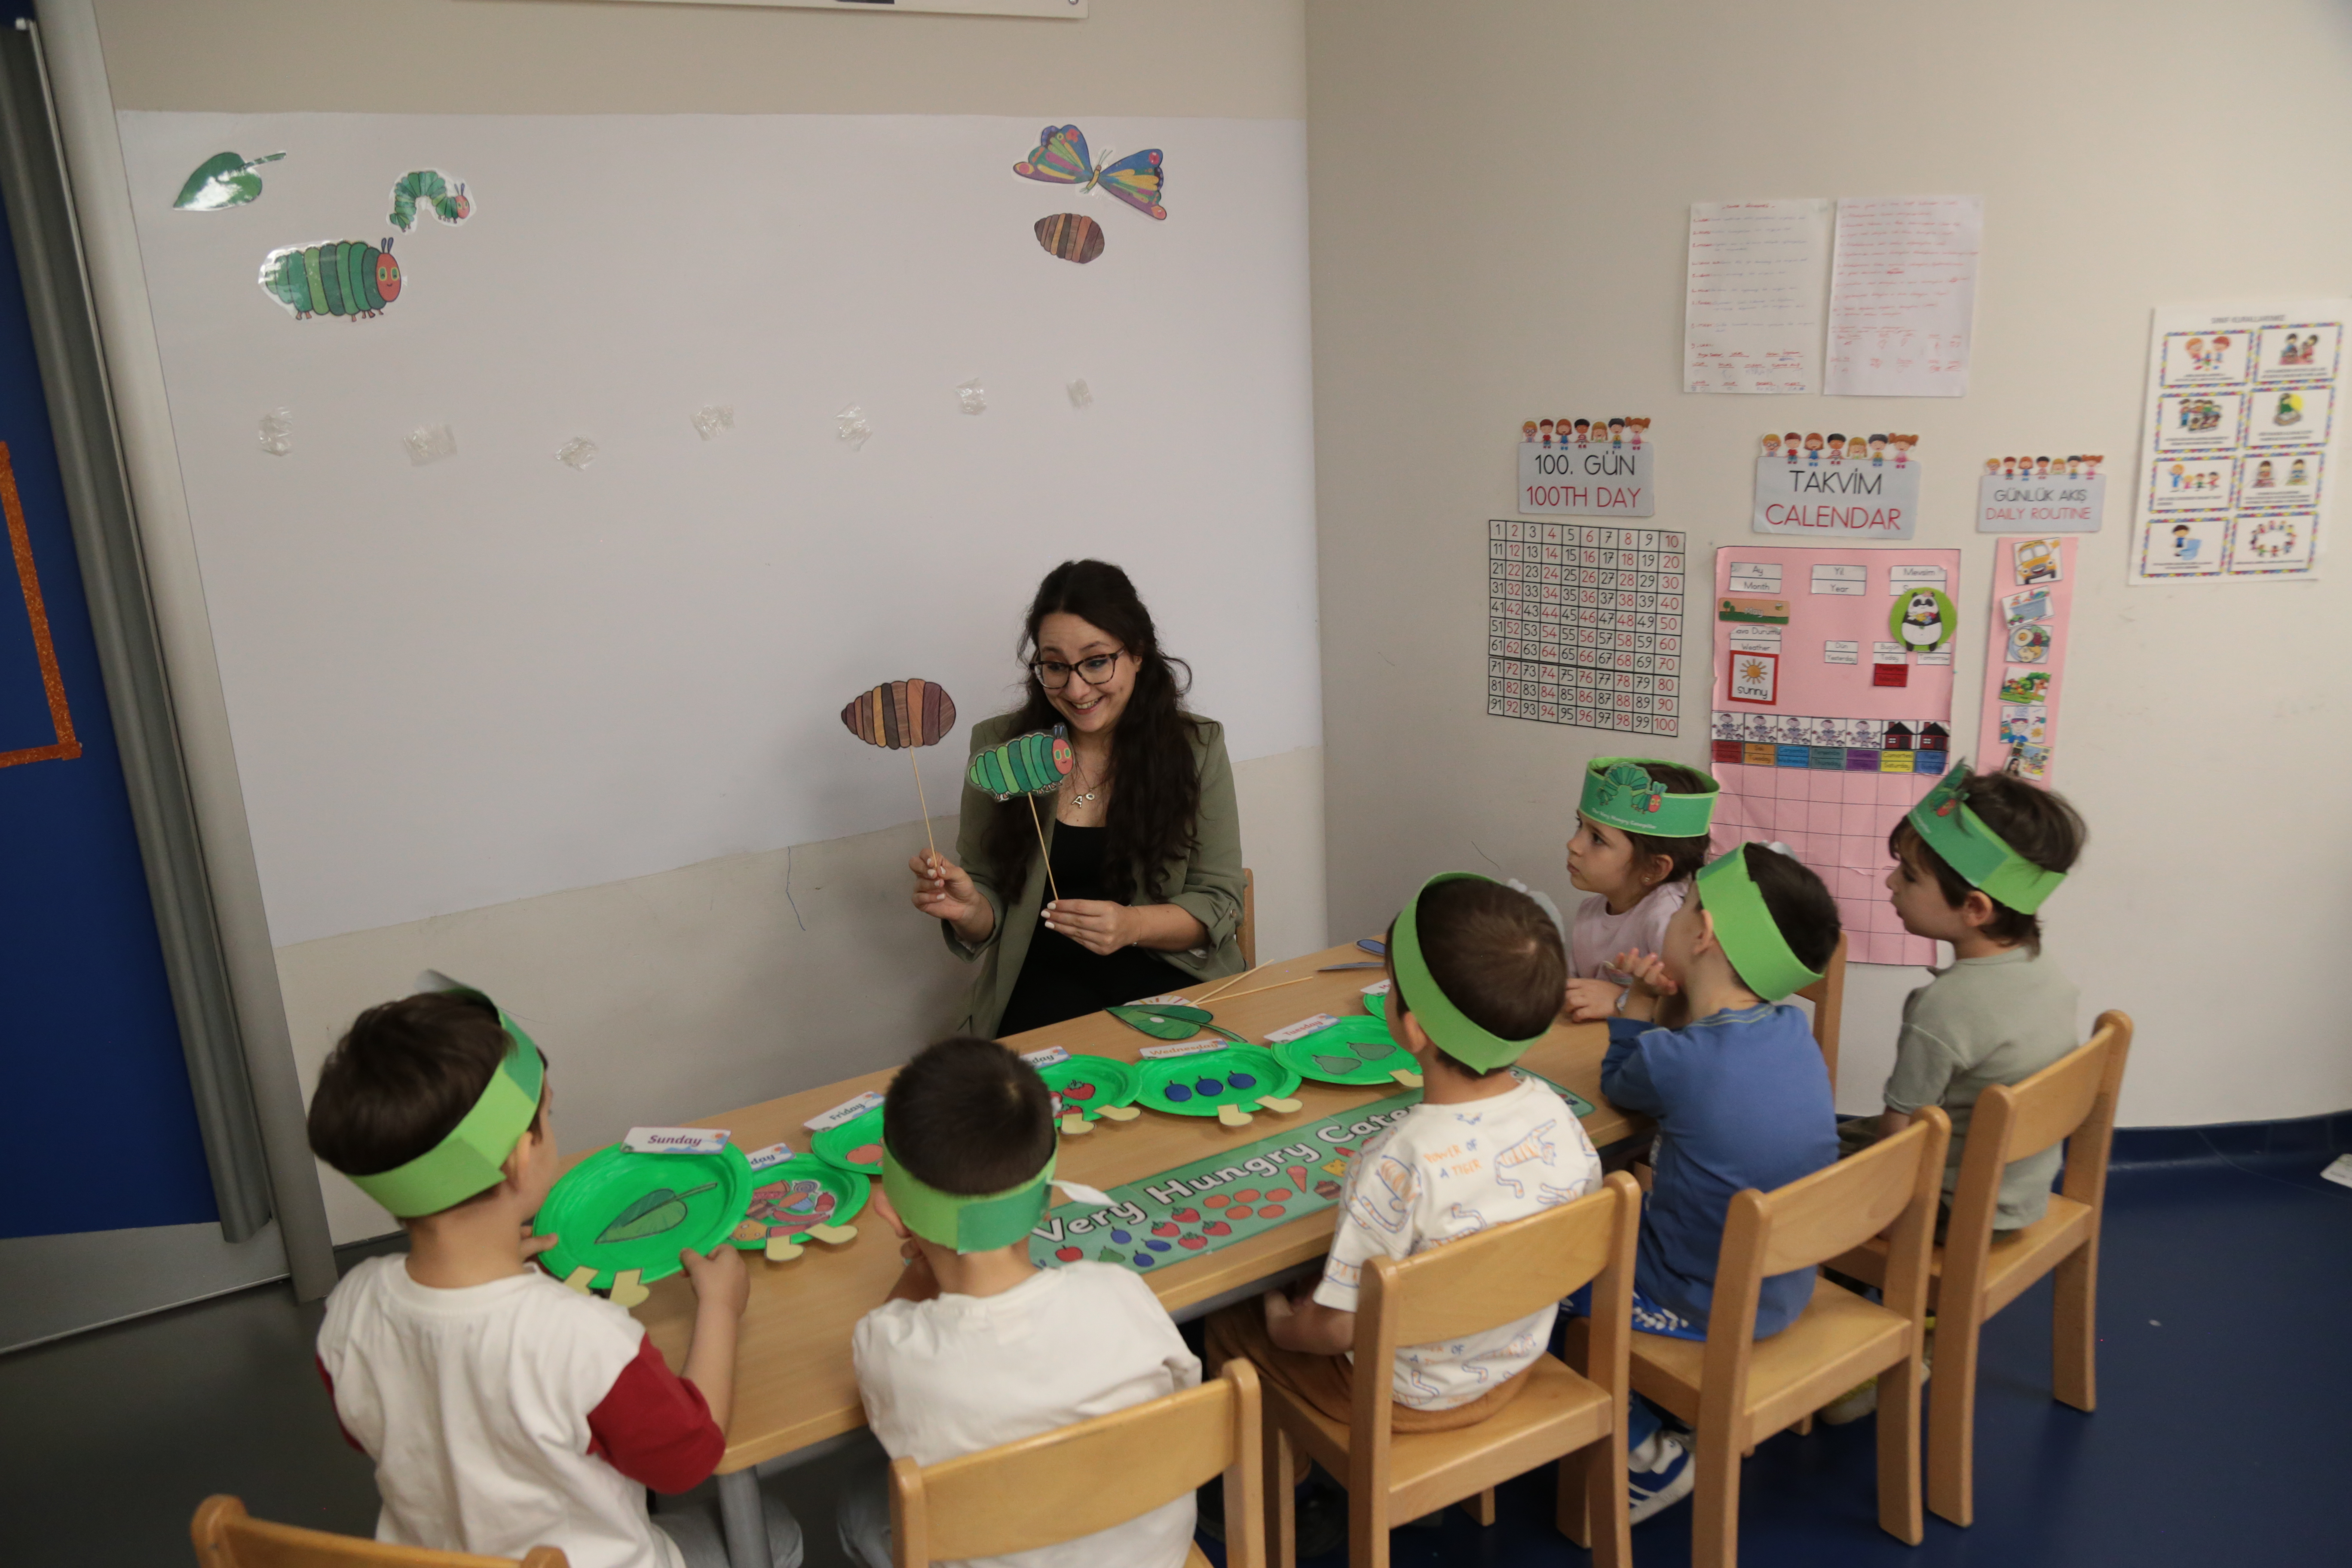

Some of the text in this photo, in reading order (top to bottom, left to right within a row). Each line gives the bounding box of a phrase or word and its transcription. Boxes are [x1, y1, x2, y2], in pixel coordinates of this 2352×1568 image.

[1535, 450, 1635, 475] 100. GÜN
[1789, 468, 1882, 494] TAKVİM
[1527, 486, 1641, 508] 100TH DAY
[1994, 487, 2087, 503] GÜNLÜK AKIŞ
[1765, 503, 1901, 530] CALENDAR
[1986, 507, 2092, 520] DAILY ROUTINE
[1495, 523, 1679, 548] 1 2 3 4 5 6 7 8 9 10
[1493, 542, 1680, 569] 11 12 13 14 15 16 17 18 19 20
[1492, 562, 1679, 589] 21 22 23 24 25 26 27 28 29 30
[1752, 565, 1764, 576] Ay
[1903, 567, 1936, 576] Mevsim
[1492, 581, 1679, 610] 31 32 33 34 35 36 37 38 39 40
[1744, 581, 1770, 591] Month
[1830, 584, 1850, 593] Year
[1491, 601, 1677, 631] 41 42 43 44 45 46 47 48 49 50
[1744, 606, 1764, 618] May
[1491, 619, 1676, 651] 51 52 53 54 55 56 57 58 59 60
[1491, 639, 1675, 671] 61 62 63 64 65 66 67 68 69 70
[1741, 643, 1771, 651] Weather
[1827, 654, 1856, 664] Yesterday
[1880, 654, 1899, 662] Today
[1491, 660, 1674, 692] 71 72 73 74 75 76 77 78 79 80
[1491, 679, 1673, 711] 81 82 83 84 85 86 87 88 89 90
[1737, 686, 1768, 699] sunny
[1490, 698, 1677, 732] 91 92 93 94 95 96 97 98 99 100
[1283, 1020, 1324, 1036] Tuesday
[1149, 1043, 1219, 1056] Wednesday
[829, 1103, 866, 1120] Friday
[647, 1134, 702, 1147] Sunday
[1423, 1138, 1477, 1164] POWER OF
[1440, 1159, 1482, 1179] A TIGER
[1031, 1200, 1148, 1243] Very
[1143, 1142, 1322, 1205] Hungry
